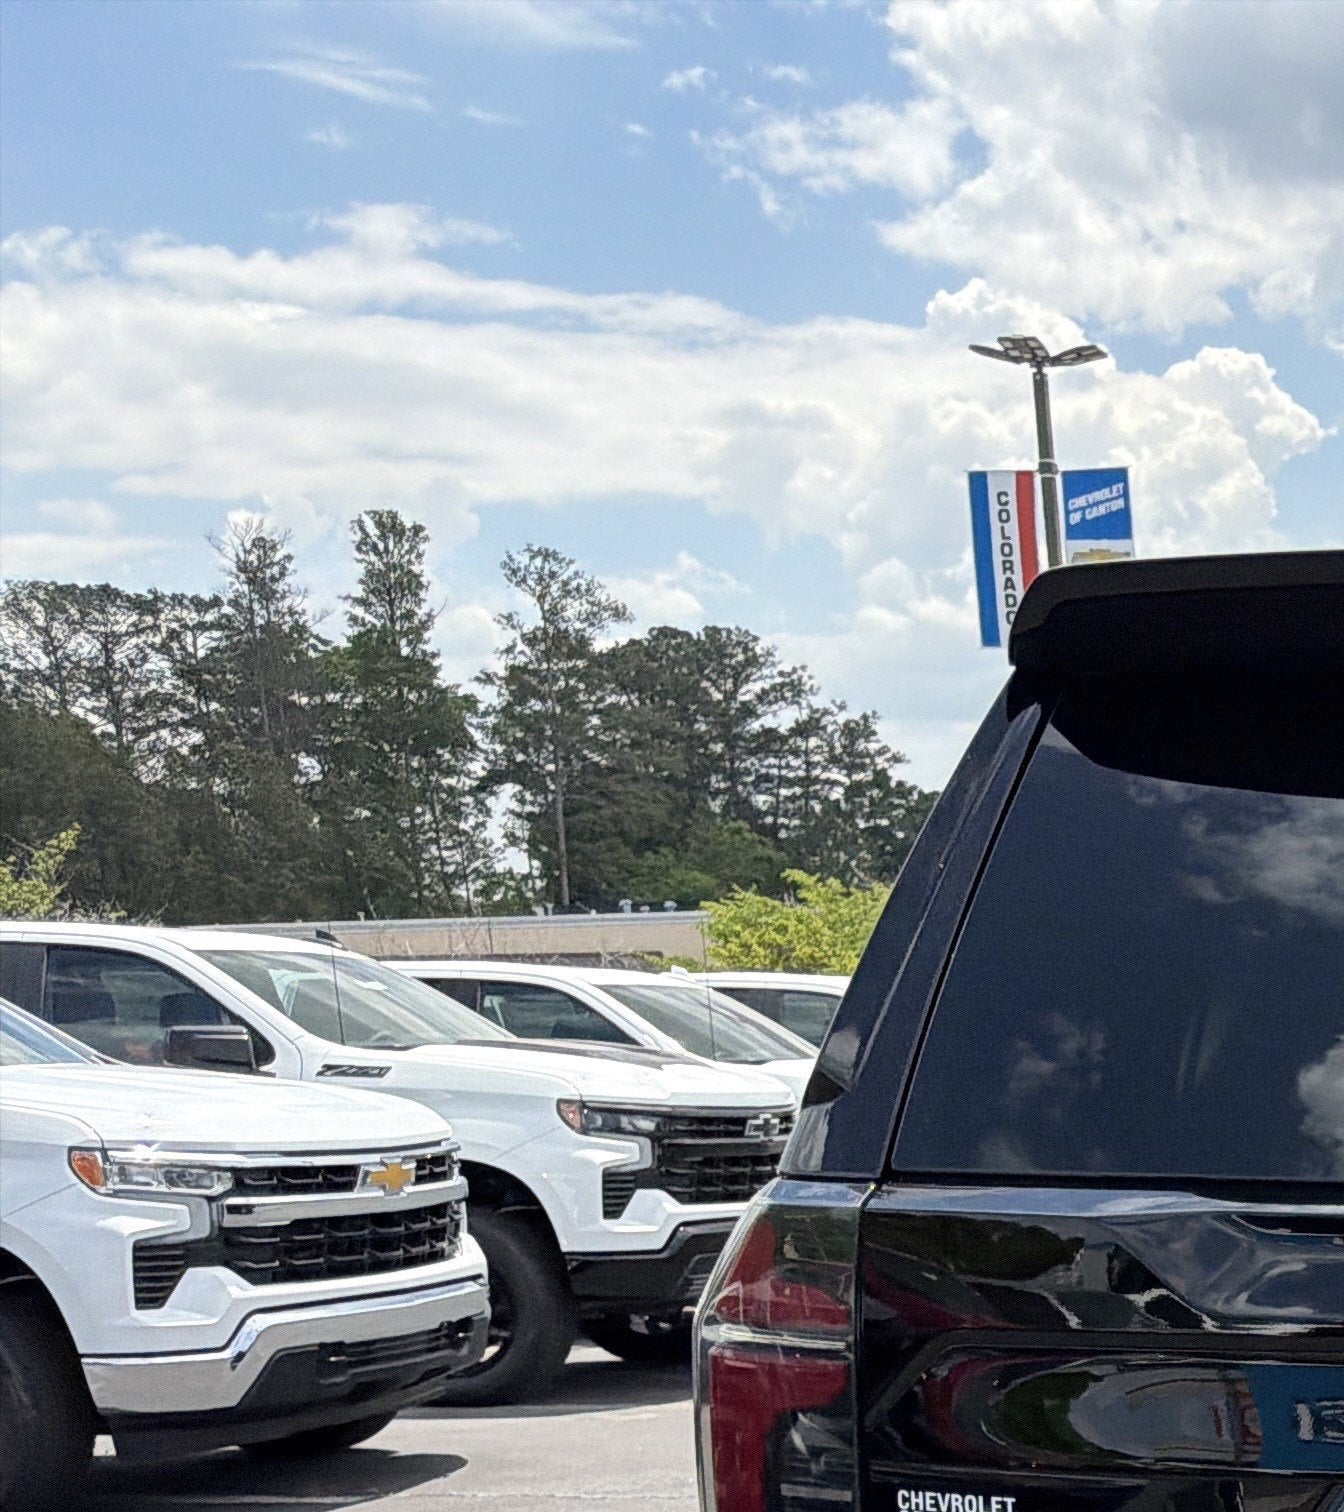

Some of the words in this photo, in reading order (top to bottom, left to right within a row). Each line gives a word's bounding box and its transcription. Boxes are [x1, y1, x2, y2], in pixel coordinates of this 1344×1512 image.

[1068, 482, 1125, 511] CHEVROLET
[1069, 510, 1084, 526] OF
[1085, 497, 1125, 521] CANTON
[996, 490, 1018, 626] COLORADO
